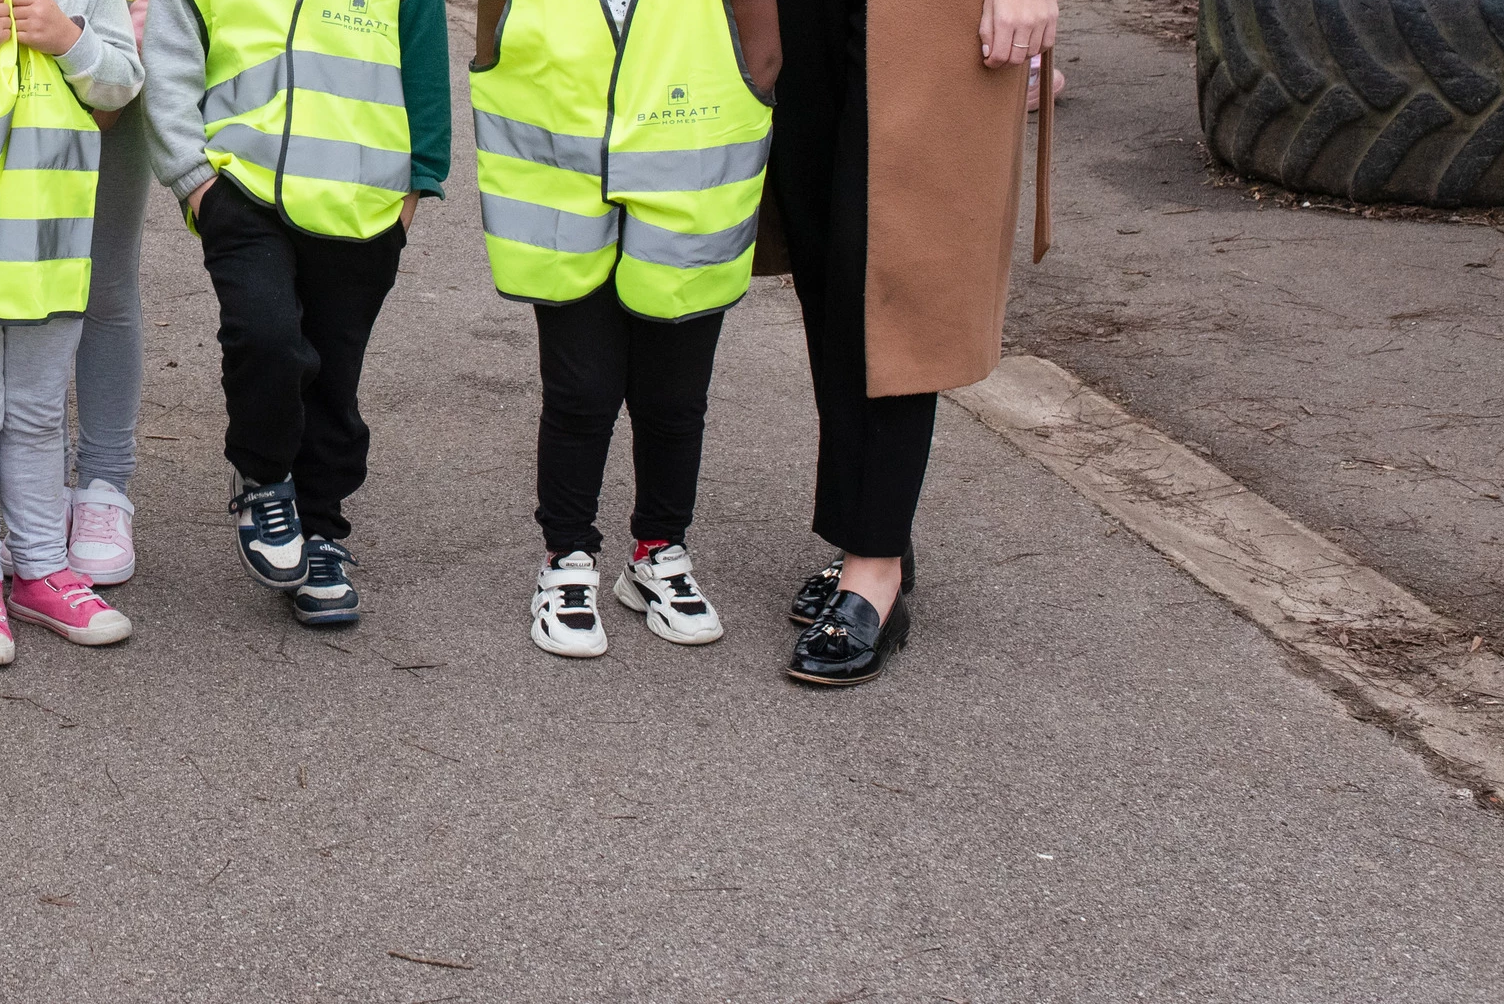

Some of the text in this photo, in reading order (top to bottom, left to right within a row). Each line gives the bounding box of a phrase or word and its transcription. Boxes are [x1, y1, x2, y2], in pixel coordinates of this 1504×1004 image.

[322, 9, 389, 32] BARRATT
[343, 24, 371, 33] HOMES
[637, 105, 721, 122] BARRATT
[243, 490, 275, 504] ellesse
[319, 543, 346, 557] ellesse
